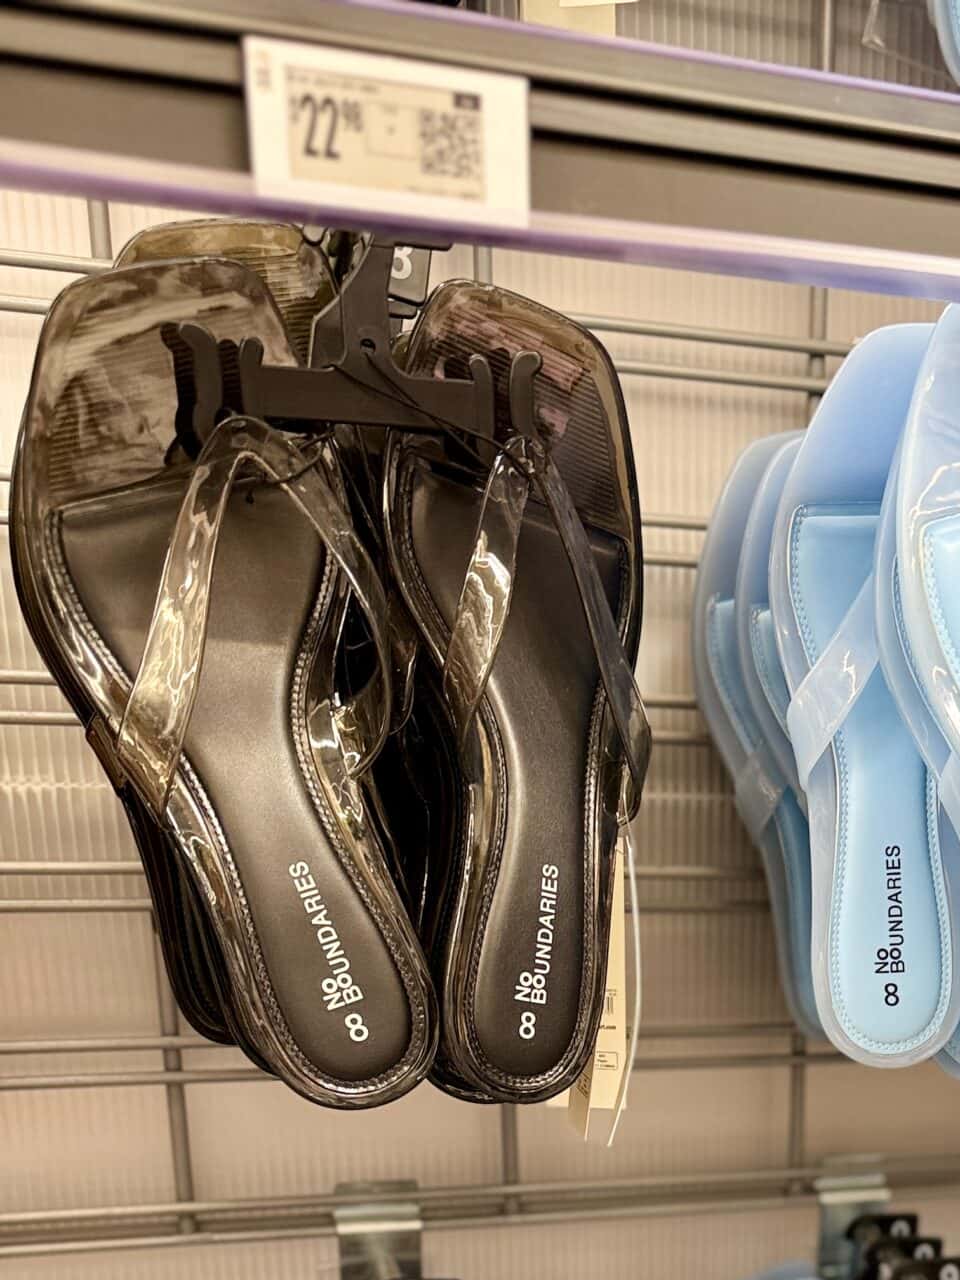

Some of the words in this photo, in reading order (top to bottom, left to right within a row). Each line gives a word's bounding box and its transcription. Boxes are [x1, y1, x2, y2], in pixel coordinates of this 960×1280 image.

[885, 845, 906, 974] BOUNDARIES
[289, 861, 364, 1005] BOUNDARIES
[530, 863, 559, 1005] BOUNDARIES
[874, 948, 889, 974] NO
[321, 977, 345, 1011] NO
[514, 971, 534, 1002] NO
[883, 982, 900, 1007] 8
[344, 1013, 369, 1042] 8
[518, 1011, 536, 1040] 8
